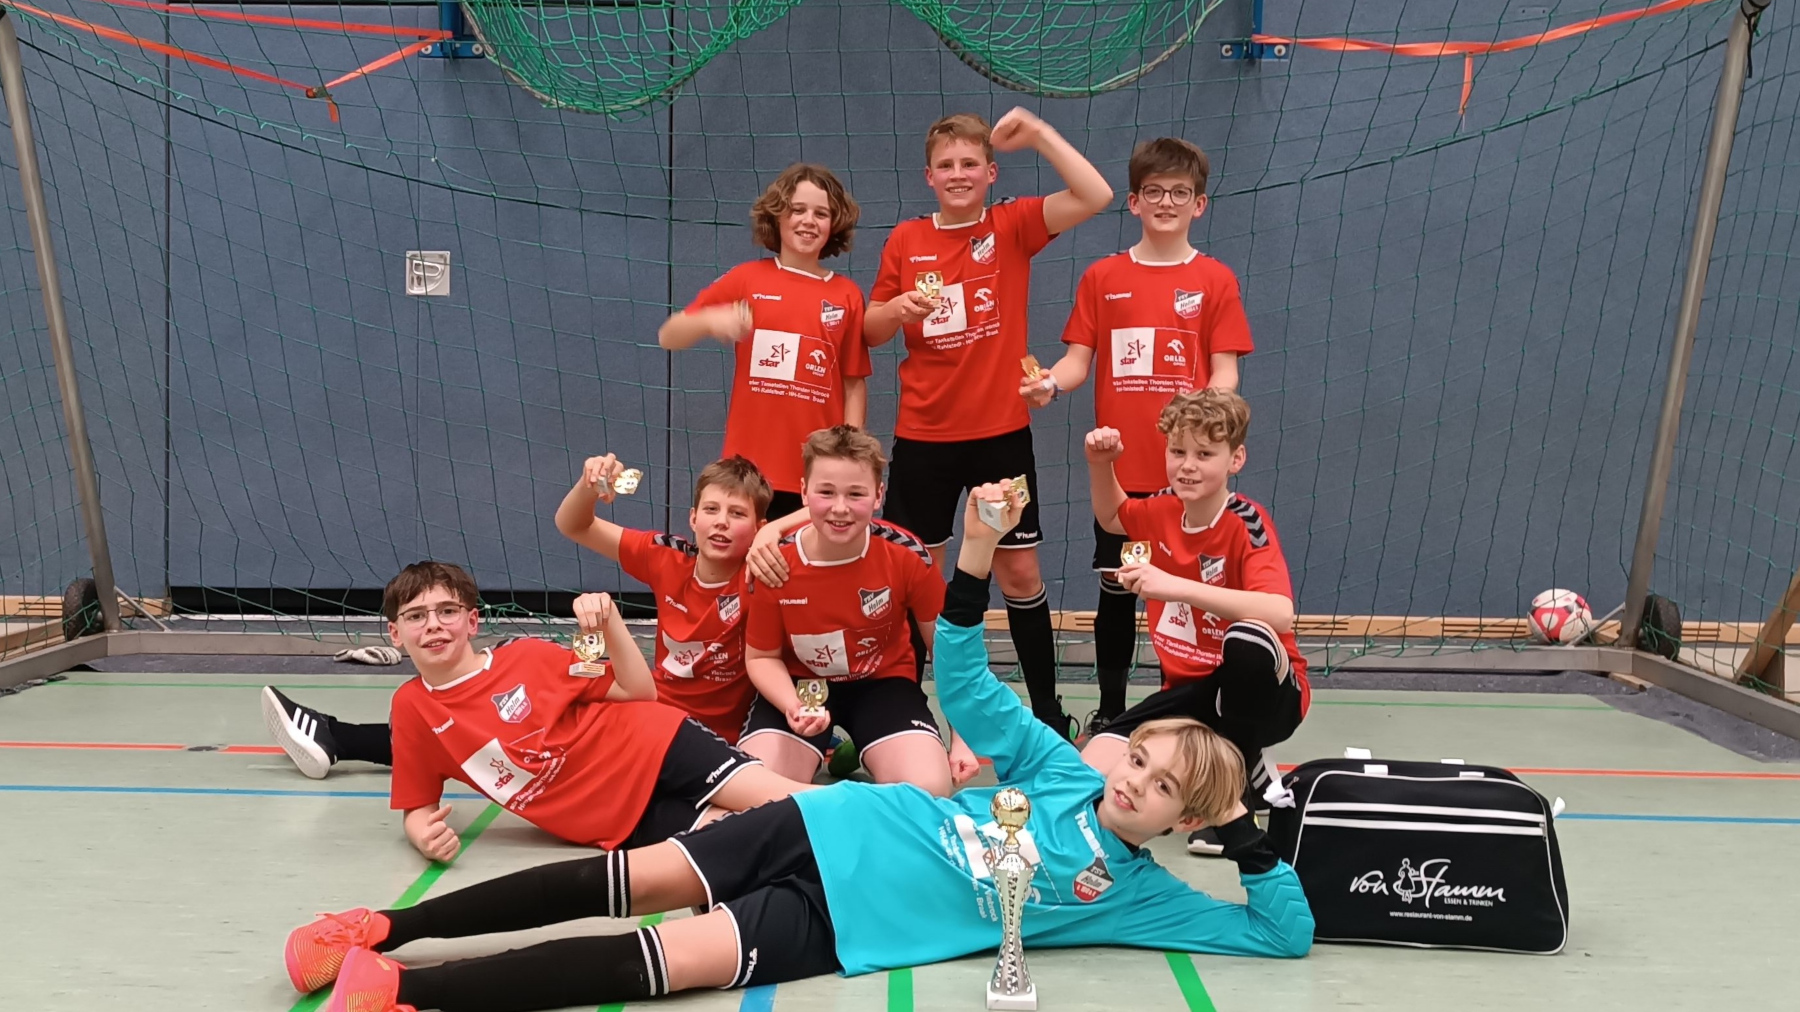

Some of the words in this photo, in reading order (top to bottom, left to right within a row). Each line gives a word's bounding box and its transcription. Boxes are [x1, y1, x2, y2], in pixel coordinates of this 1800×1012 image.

[930, 315, 951, 326] star
[758, 358, 780, 368] star
[1120, 356, 1137, 366] star
[805, 363, 827, 374] ORLEN
[783, 597, 808, 605] hummel
[868, 597, 884, 612] Holm
[724, 601, 739, 617] Holm
[1168, 615, 1187, 628] star
[1202, 627, 1224, 637] ORLEN
[805, 659, 829, 668] star
[505, 696, 520, 715] Holm
[494, 772, 515, 790] star
[1075, 810, 1110, 860] hummel
[1090, 865, 1106, 876] TSV
[1350, 870, 1389, 896] von
[1393, 858, 1507, 908] Stamm
[1444, 897, 1462, 905] ESSEN
[1463, 898, 1468, 906] &
[1469, 898, 1494, 907] TRINKEN
[1389, 910, 1473, 922] www.restaurant-von-stamm.de
